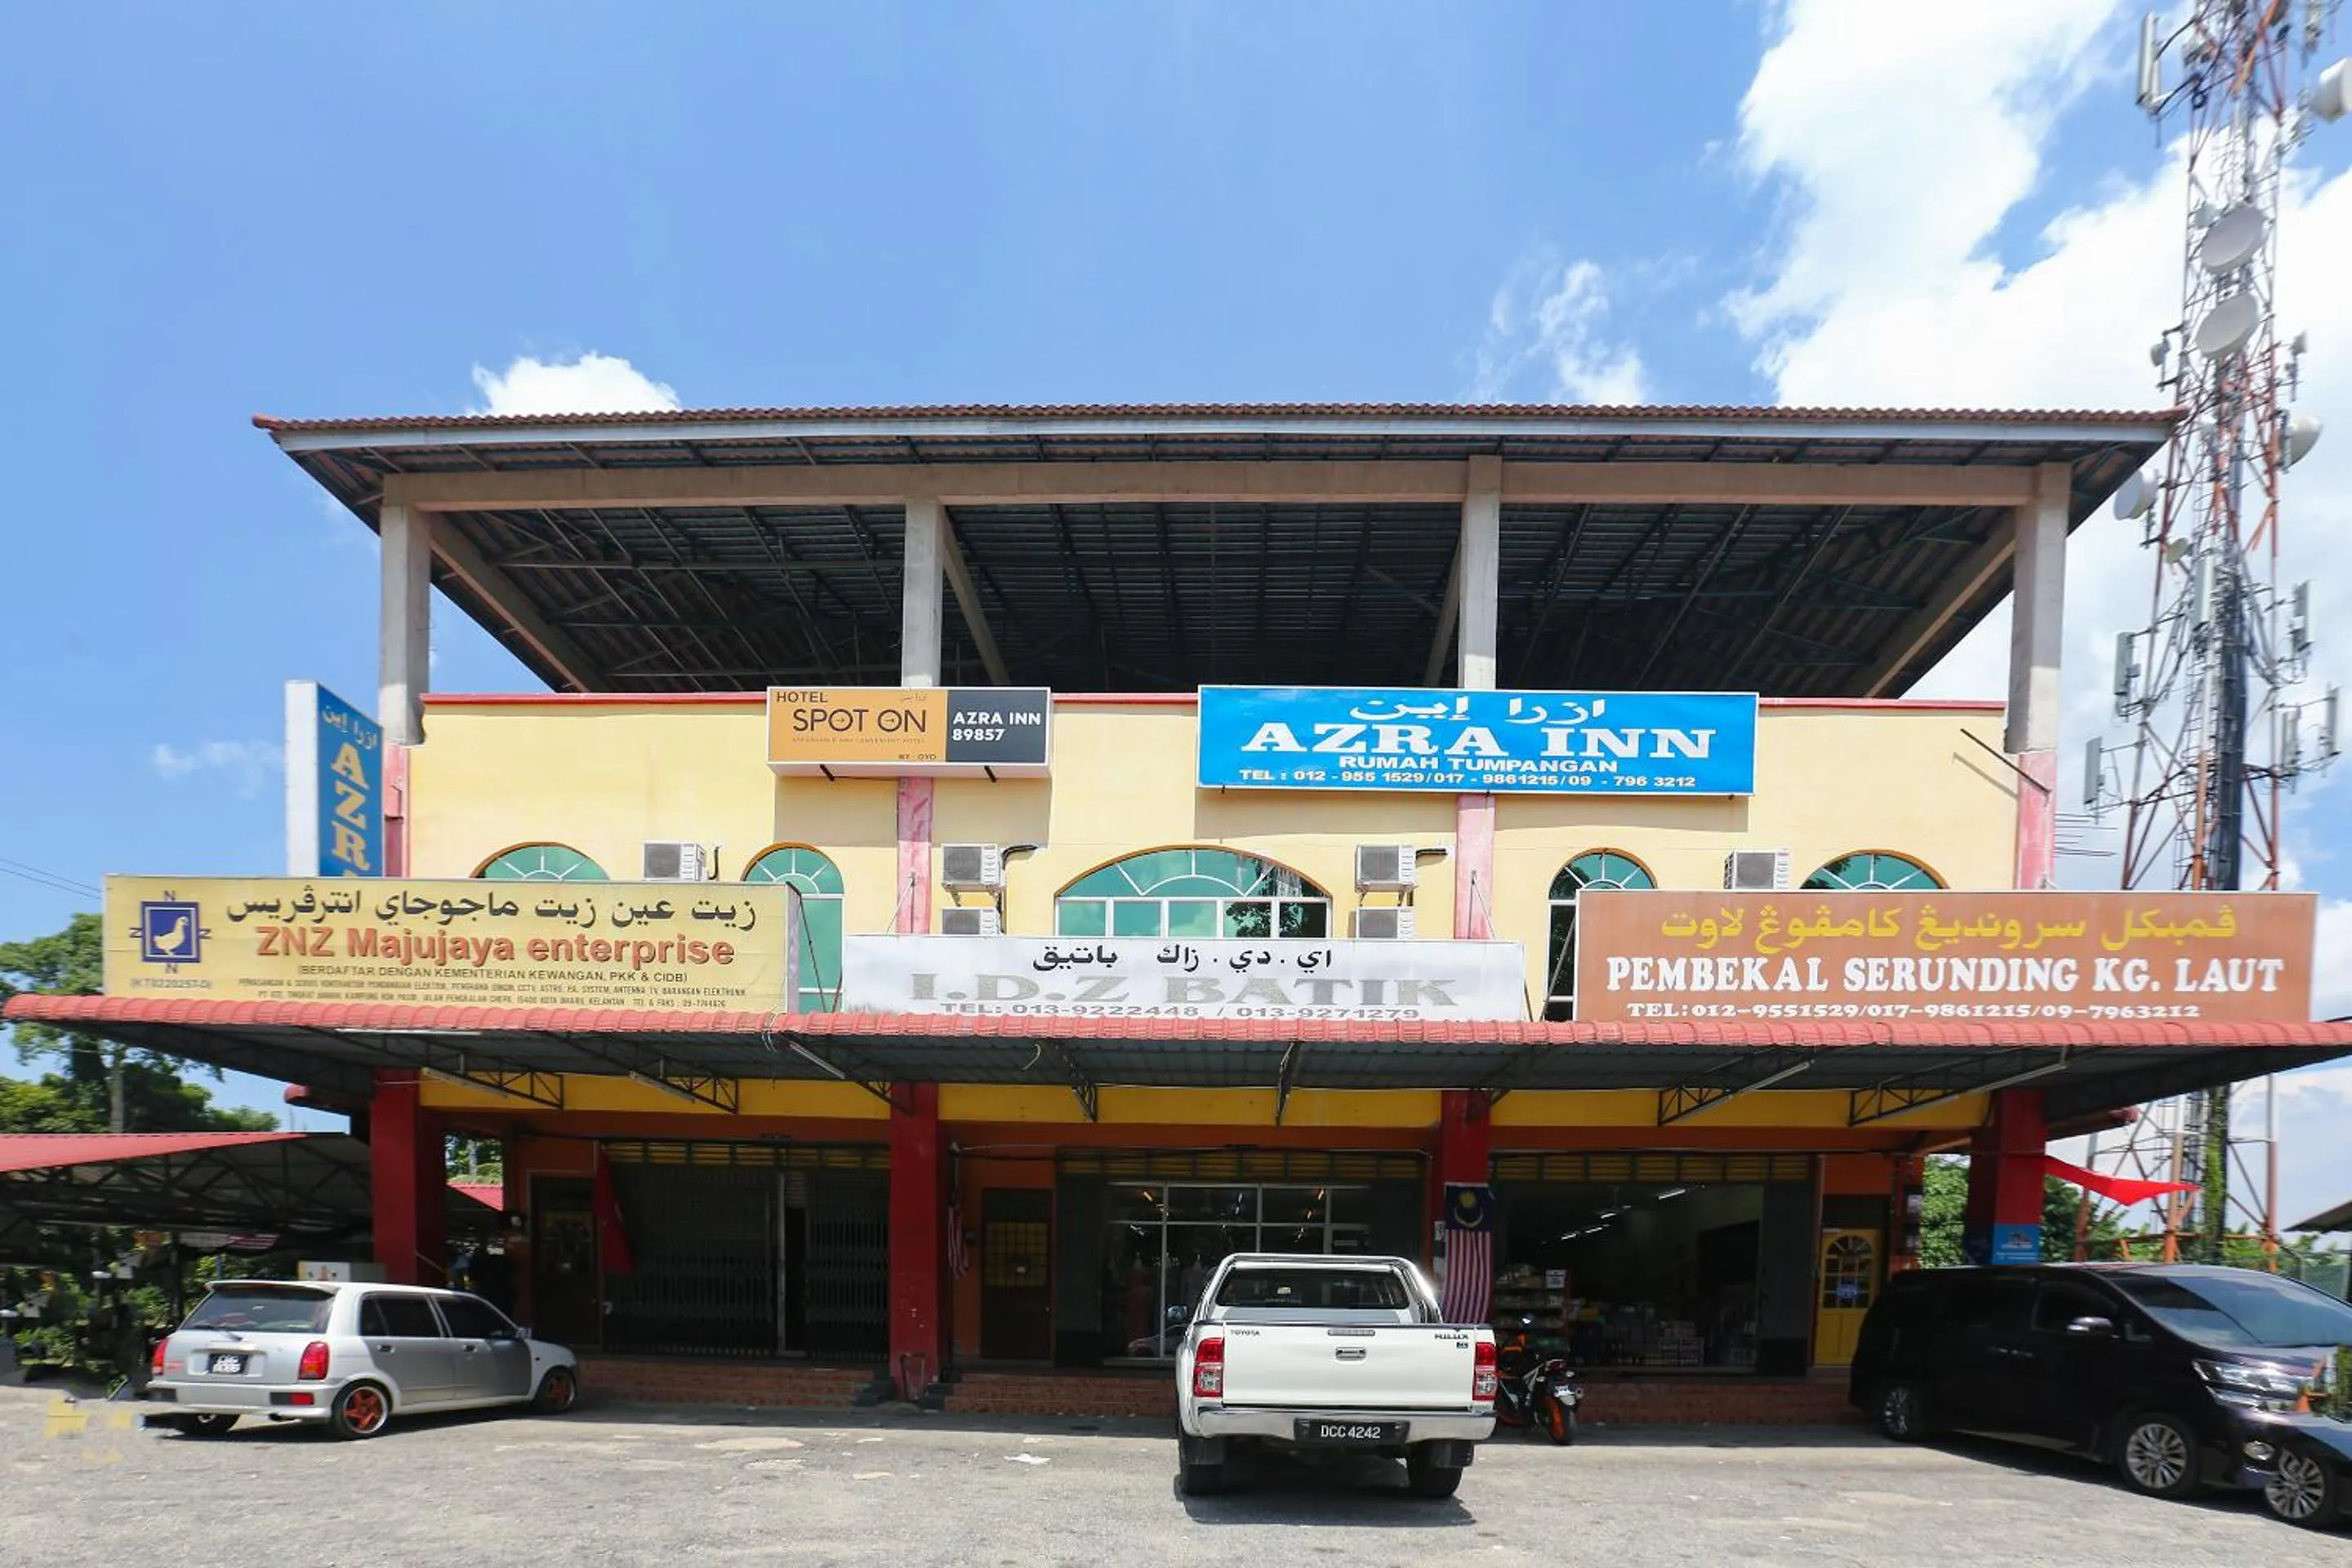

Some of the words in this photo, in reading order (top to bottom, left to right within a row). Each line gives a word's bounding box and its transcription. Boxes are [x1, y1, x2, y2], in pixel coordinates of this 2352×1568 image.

[777, 690, 828, 703] HOTEL
[792, 708, 870, 733] SPOT
[877, 709, 927, 733] ON
[952, 711, 1004, 725] AZRA
[1009, 712, 1041, 726] INN
[951, 728, 1007, 742] 89857
[1241, 721, 1510, 756] AZRA
[1539, 727, 1717, 759] INN
[1339, 755, 1438, 770] RUMAH
[1447, 758, 1618, 773] TUMPANGAN
[1293, 770, 1326, 782] 012
[1341, 771, 1376, 782] 955
[1613, 775, 1648, 786] 796
[1654, 777, 1696, 787] 3212
[330, 741, 371, 877] AZR
[375, 889, 520, 926] ماجوجاي
[535, 898, 597, 929] زيت
[611, 900, 675, 928] عين
[692, 898, 756, 931] زيت
[1660, 907, 1746, 950] لاوت
[255, 926, 336, 957] ZNZ
[346, 928, 515, 967] Majujaya
[526, 933, 735, 970] enterprise
[1032, 944, 1118, 971] باتيق
[378, 966, 431, 978] DENGAN
[434, 968, 525, 979] KEMENTERIAN
[609, 971, 636, 981] PKK
[640, 971, 649, 982] &
[653, 972, 688, 982] CIDB)
[1606, 956, 1829, 992] PEMBEKAL
[1843, 956, 2080, 992] SERUNDING
[2093, 957, 2162, 992] KG.
[2173, 957, 2285, 992] LAUT
[1163, 976, 1459, 1007] BATIK
[1012, 1003, 1200, 1017] 013-9222448
[1236, 1006, 1420, 1019] 013-9271279
[1321, 1424, 1347, 1437] DCC
[1348, 1426, 1381, 1439] 4242
